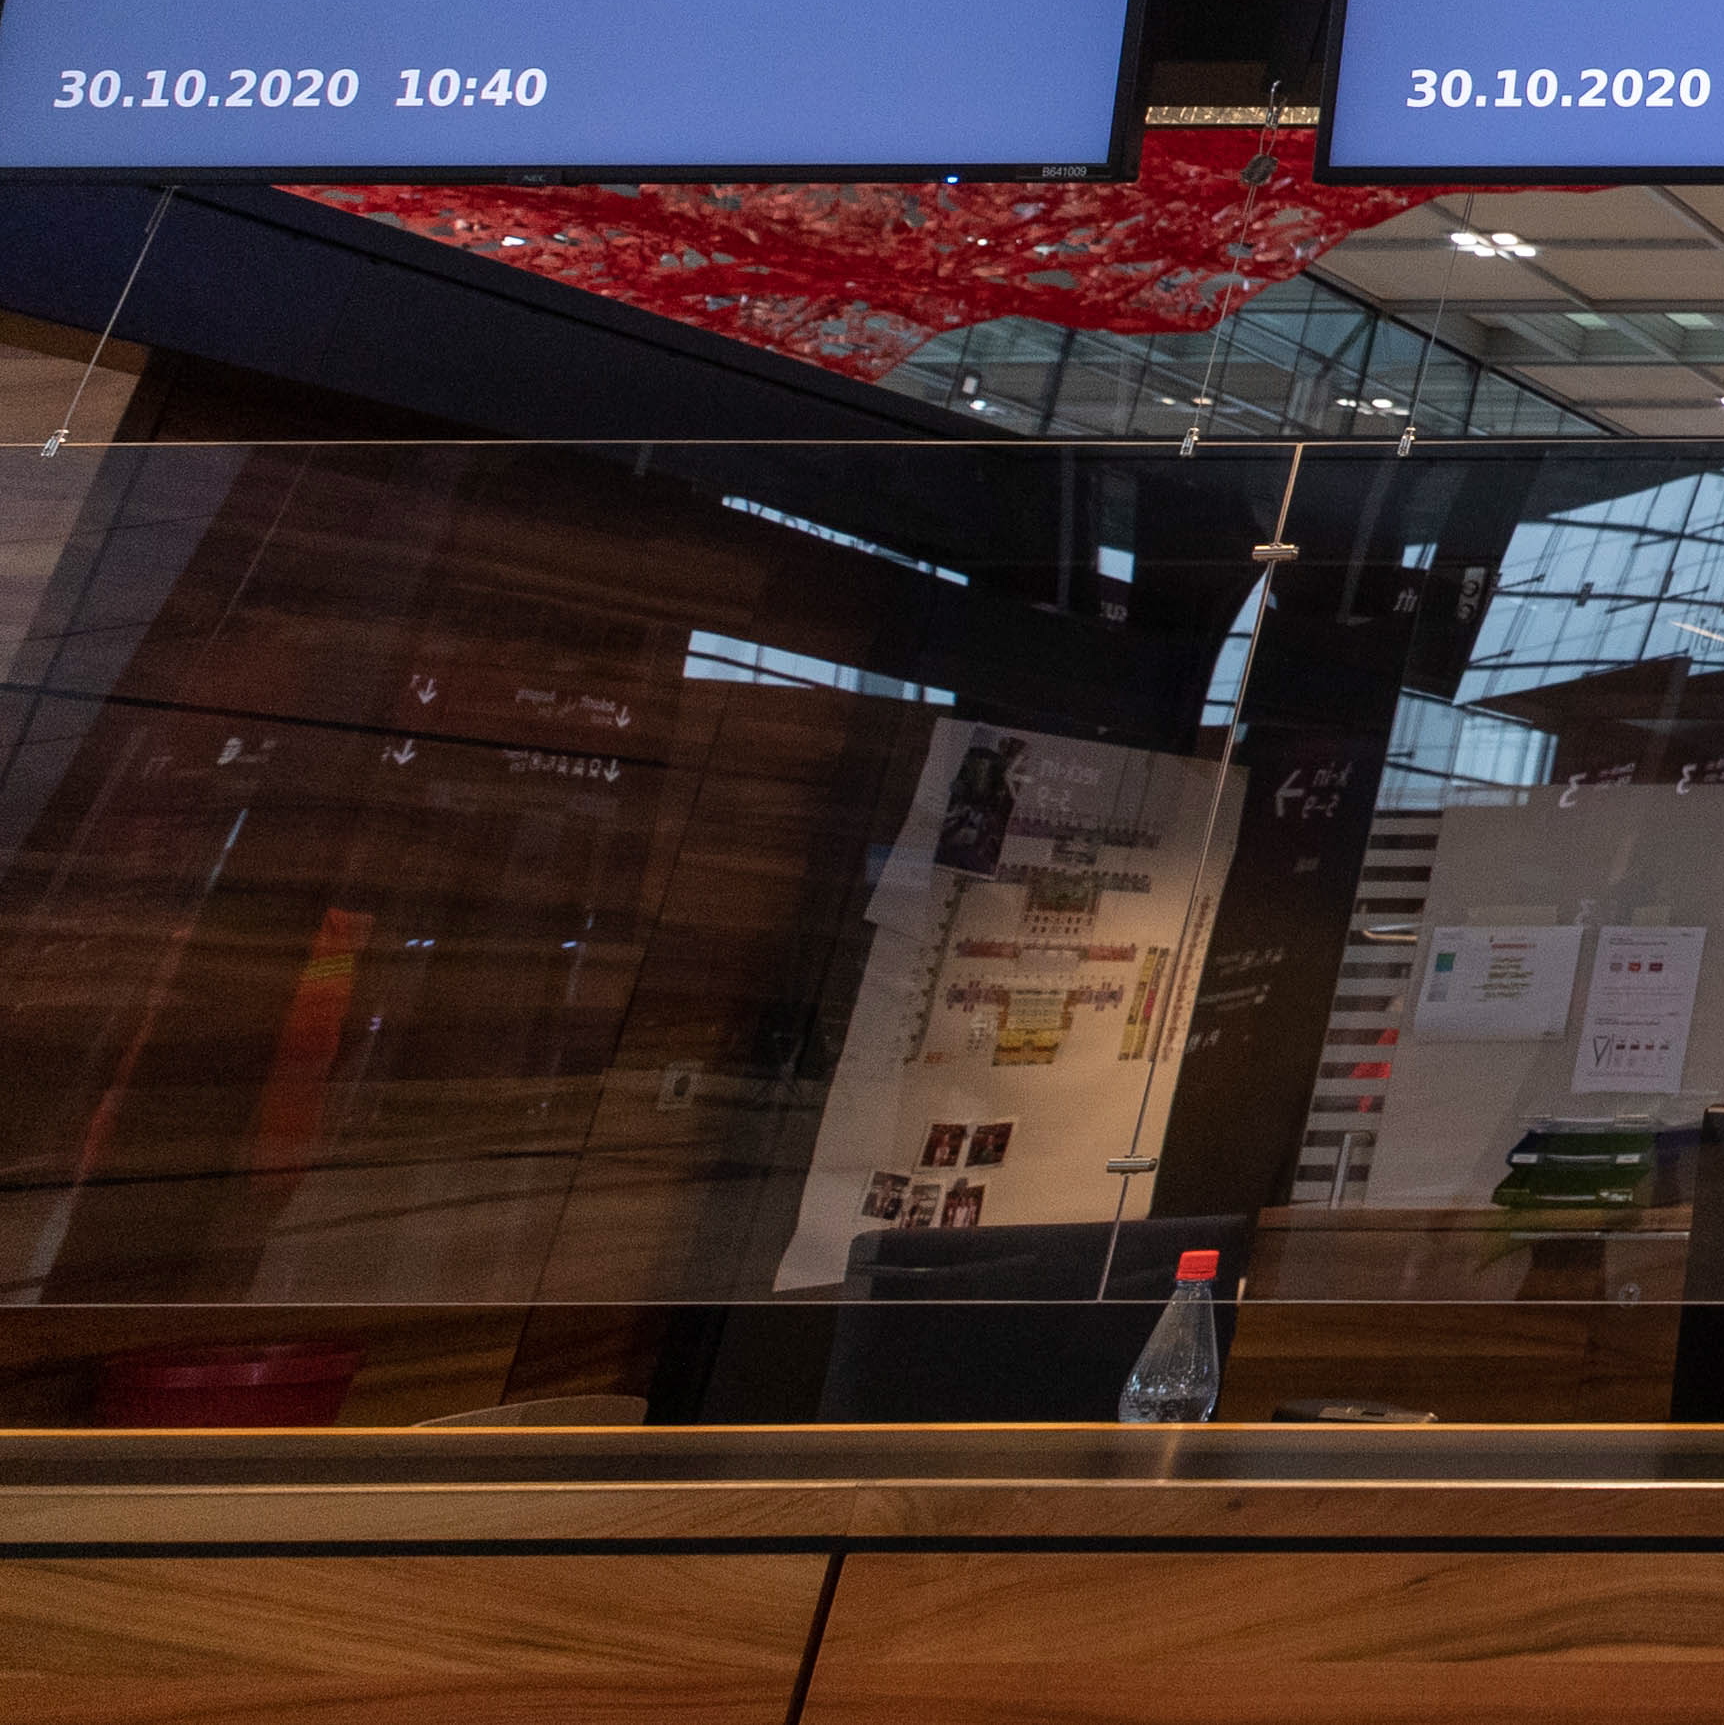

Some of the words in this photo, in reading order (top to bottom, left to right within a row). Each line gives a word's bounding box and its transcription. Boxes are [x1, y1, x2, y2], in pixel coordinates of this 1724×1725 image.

[53, 68, 359, 108] 30.10.2020
[395, 68, 547, 107] 10:40
[1406, 68, 1711, 108] 30.10.2020
[1042, 165, 1087, 177] B641009
